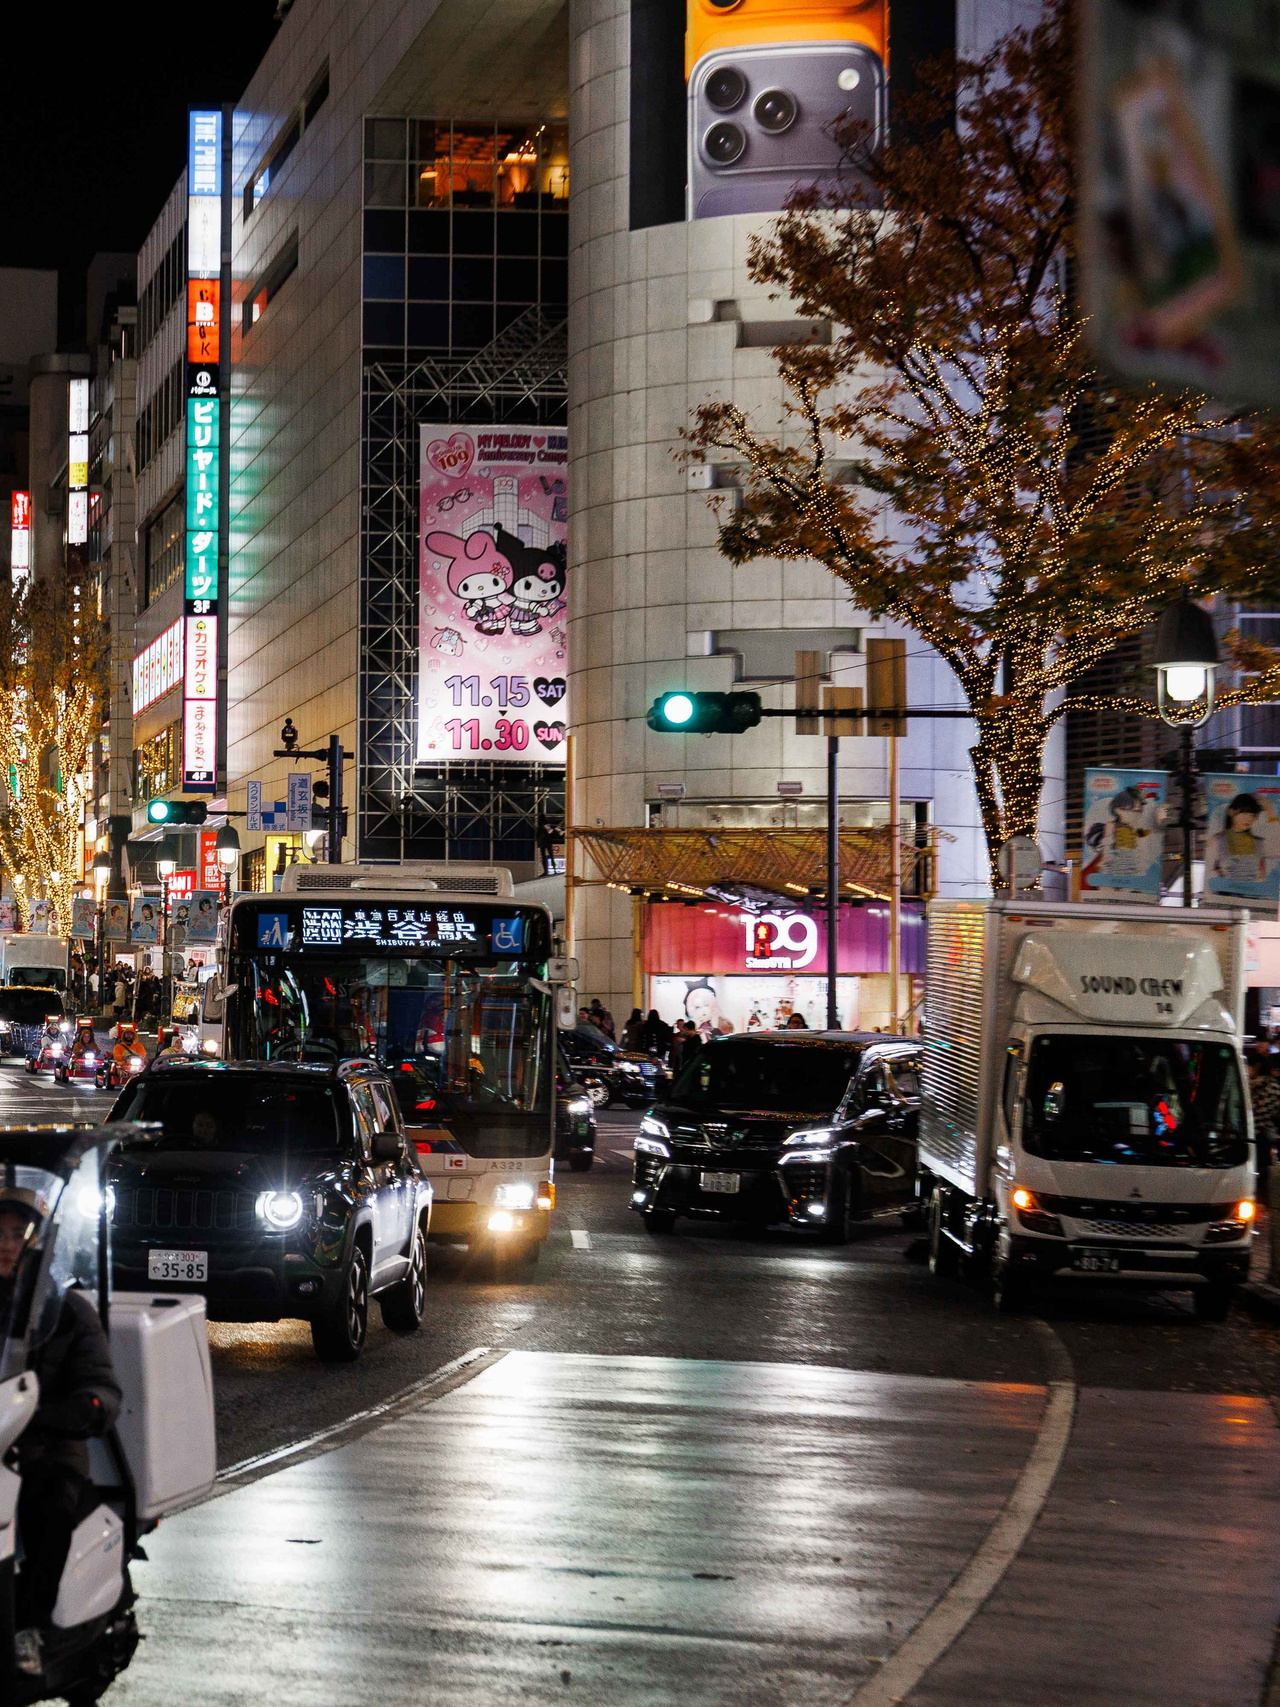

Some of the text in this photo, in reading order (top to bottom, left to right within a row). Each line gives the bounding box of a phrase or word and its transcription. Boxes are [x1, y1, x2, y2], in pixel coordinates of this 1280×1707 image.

[195, 115, 216, 143] THE
[195, 147, 216, 193] PRIME
[477, 435, 493, 449] MY
[494, 435, 532, 449] MELODY
[438, 451, 469, 471] 109
[477, 450, 536, 465] Anniversary
[192, 401, 213, 596] ビリヤード・ダーツ
[193, 600, 210, 613] 3F
[194, 631, 208, 684] カラオケ
[444, 675, 565, 708] 11.15 SAT
[193, 705, 207, 769] まねきねこ
[444, 718, 563, 751] 11.30 SUN
[192, 772, 207, 781] 4F
[250, 783, 258, 829] スクランブル式
[297, 777, 308, 827] 道玄坂下
[168, 876, 192, 890] UNI
[354, 908, 465, 922] 東急百貨店経由
[343, 920, 477, 941] 渋谷駅
[375, 939, 441, 947] SHIBUYA STA.
[740, 914, 818, 969] 109
[1080, 975, 1184, 997] SOUND CREW
[490, 1161, 523, 1170] A322
[161, 1262, 206, 1280] 35-85
